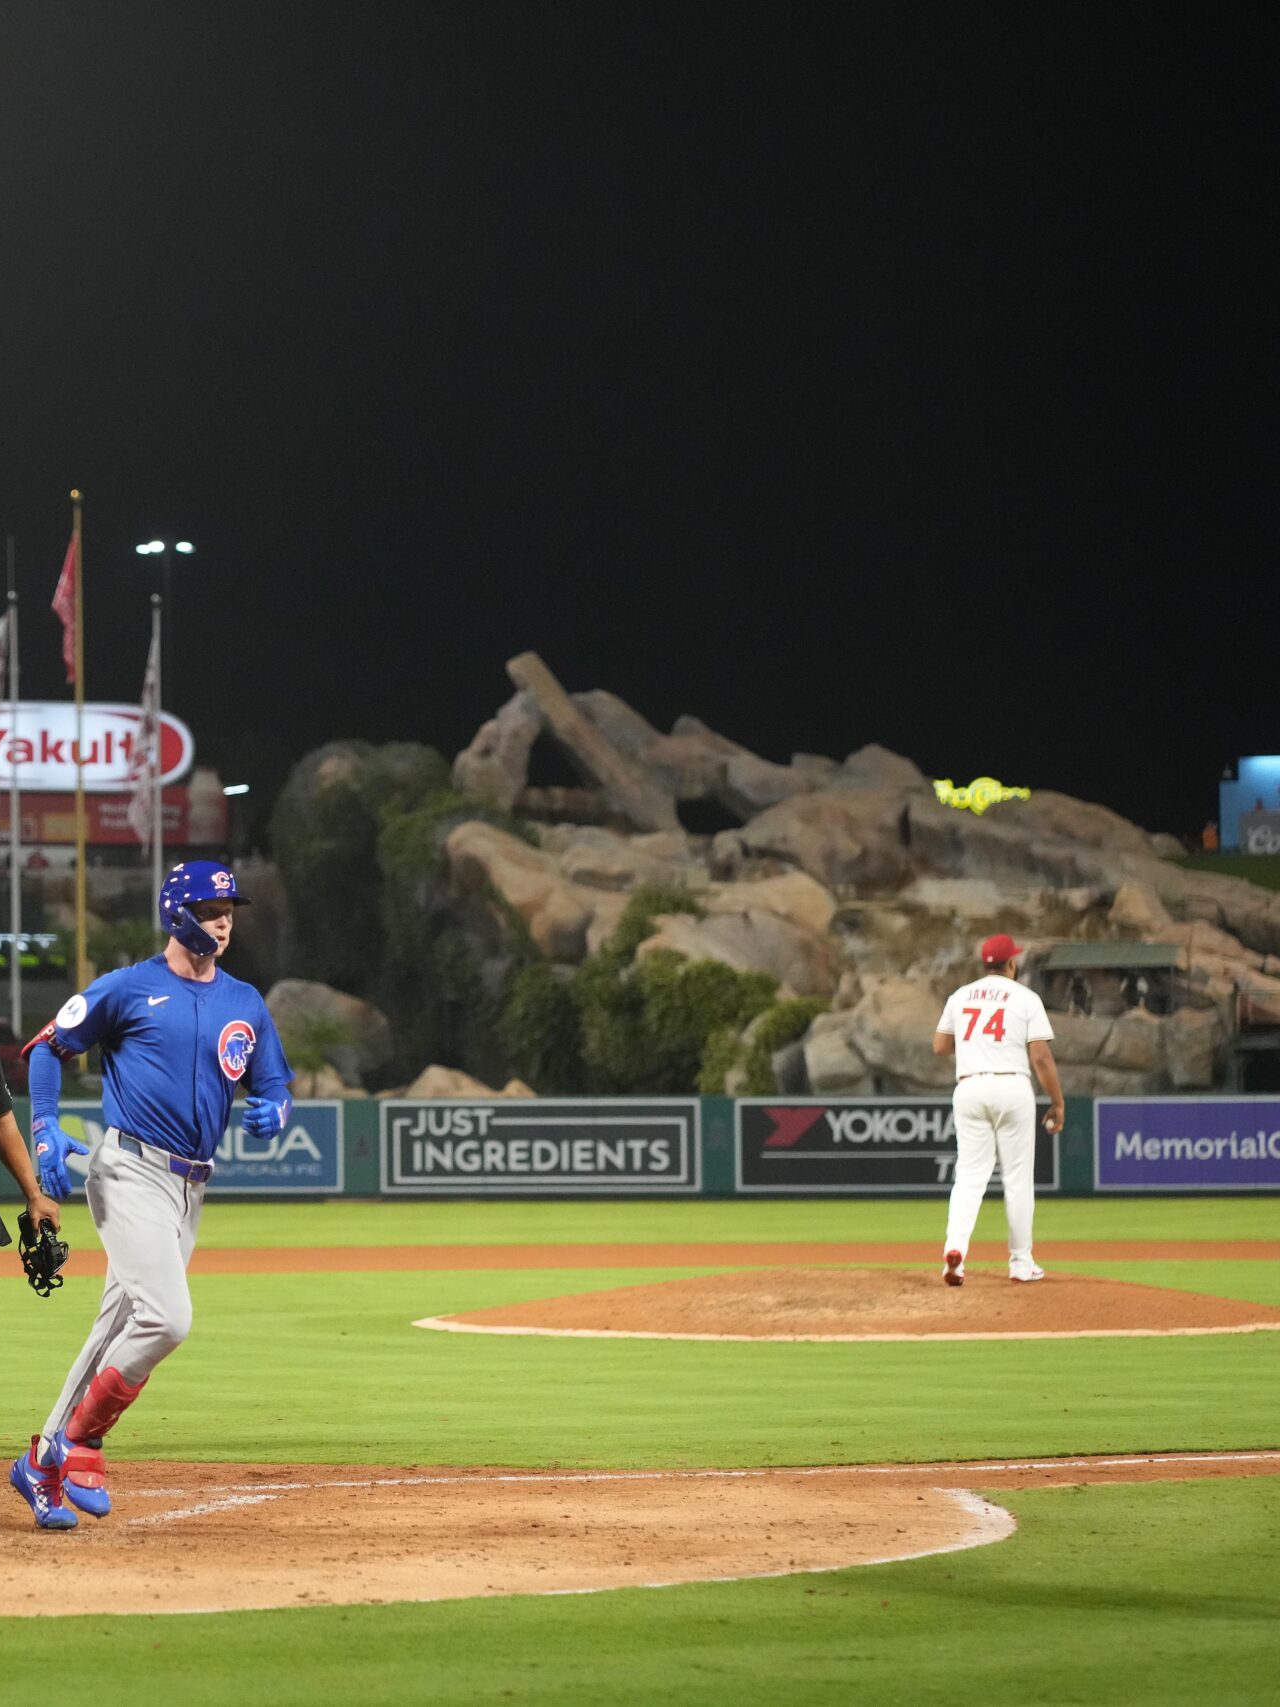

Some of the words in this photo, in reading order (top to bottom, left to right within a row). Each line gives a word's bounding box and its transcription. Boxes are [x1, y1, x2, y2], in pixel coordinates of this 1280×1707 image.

[962, 1007, 1006, 1042] 74
[410, 1108, 494, 1137] JUST
[825, 1108, 956, 1143] YOKOHA
[412, 1139, 671, 1172] INGREDIENTS
